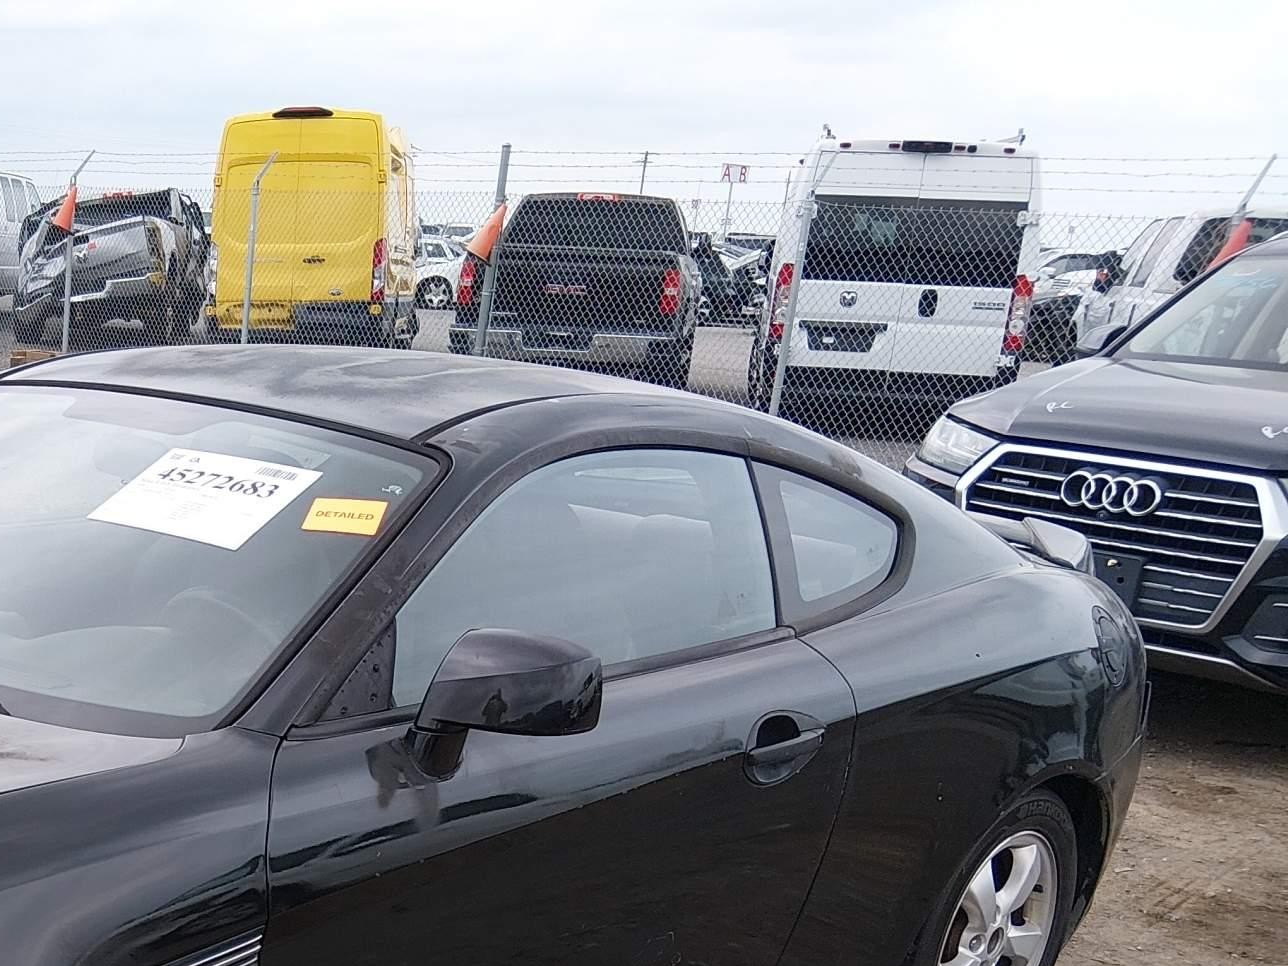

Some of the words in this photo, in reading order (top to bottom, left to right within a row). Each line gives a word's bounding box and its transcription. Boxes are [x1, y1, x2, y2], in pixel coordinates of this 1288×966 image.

[721, 164, 731, 182] A
[739, 166, 747, 183] B
[158, 467, 280, 498] 45272683
[315, 510, 374, 521] DETAILED
